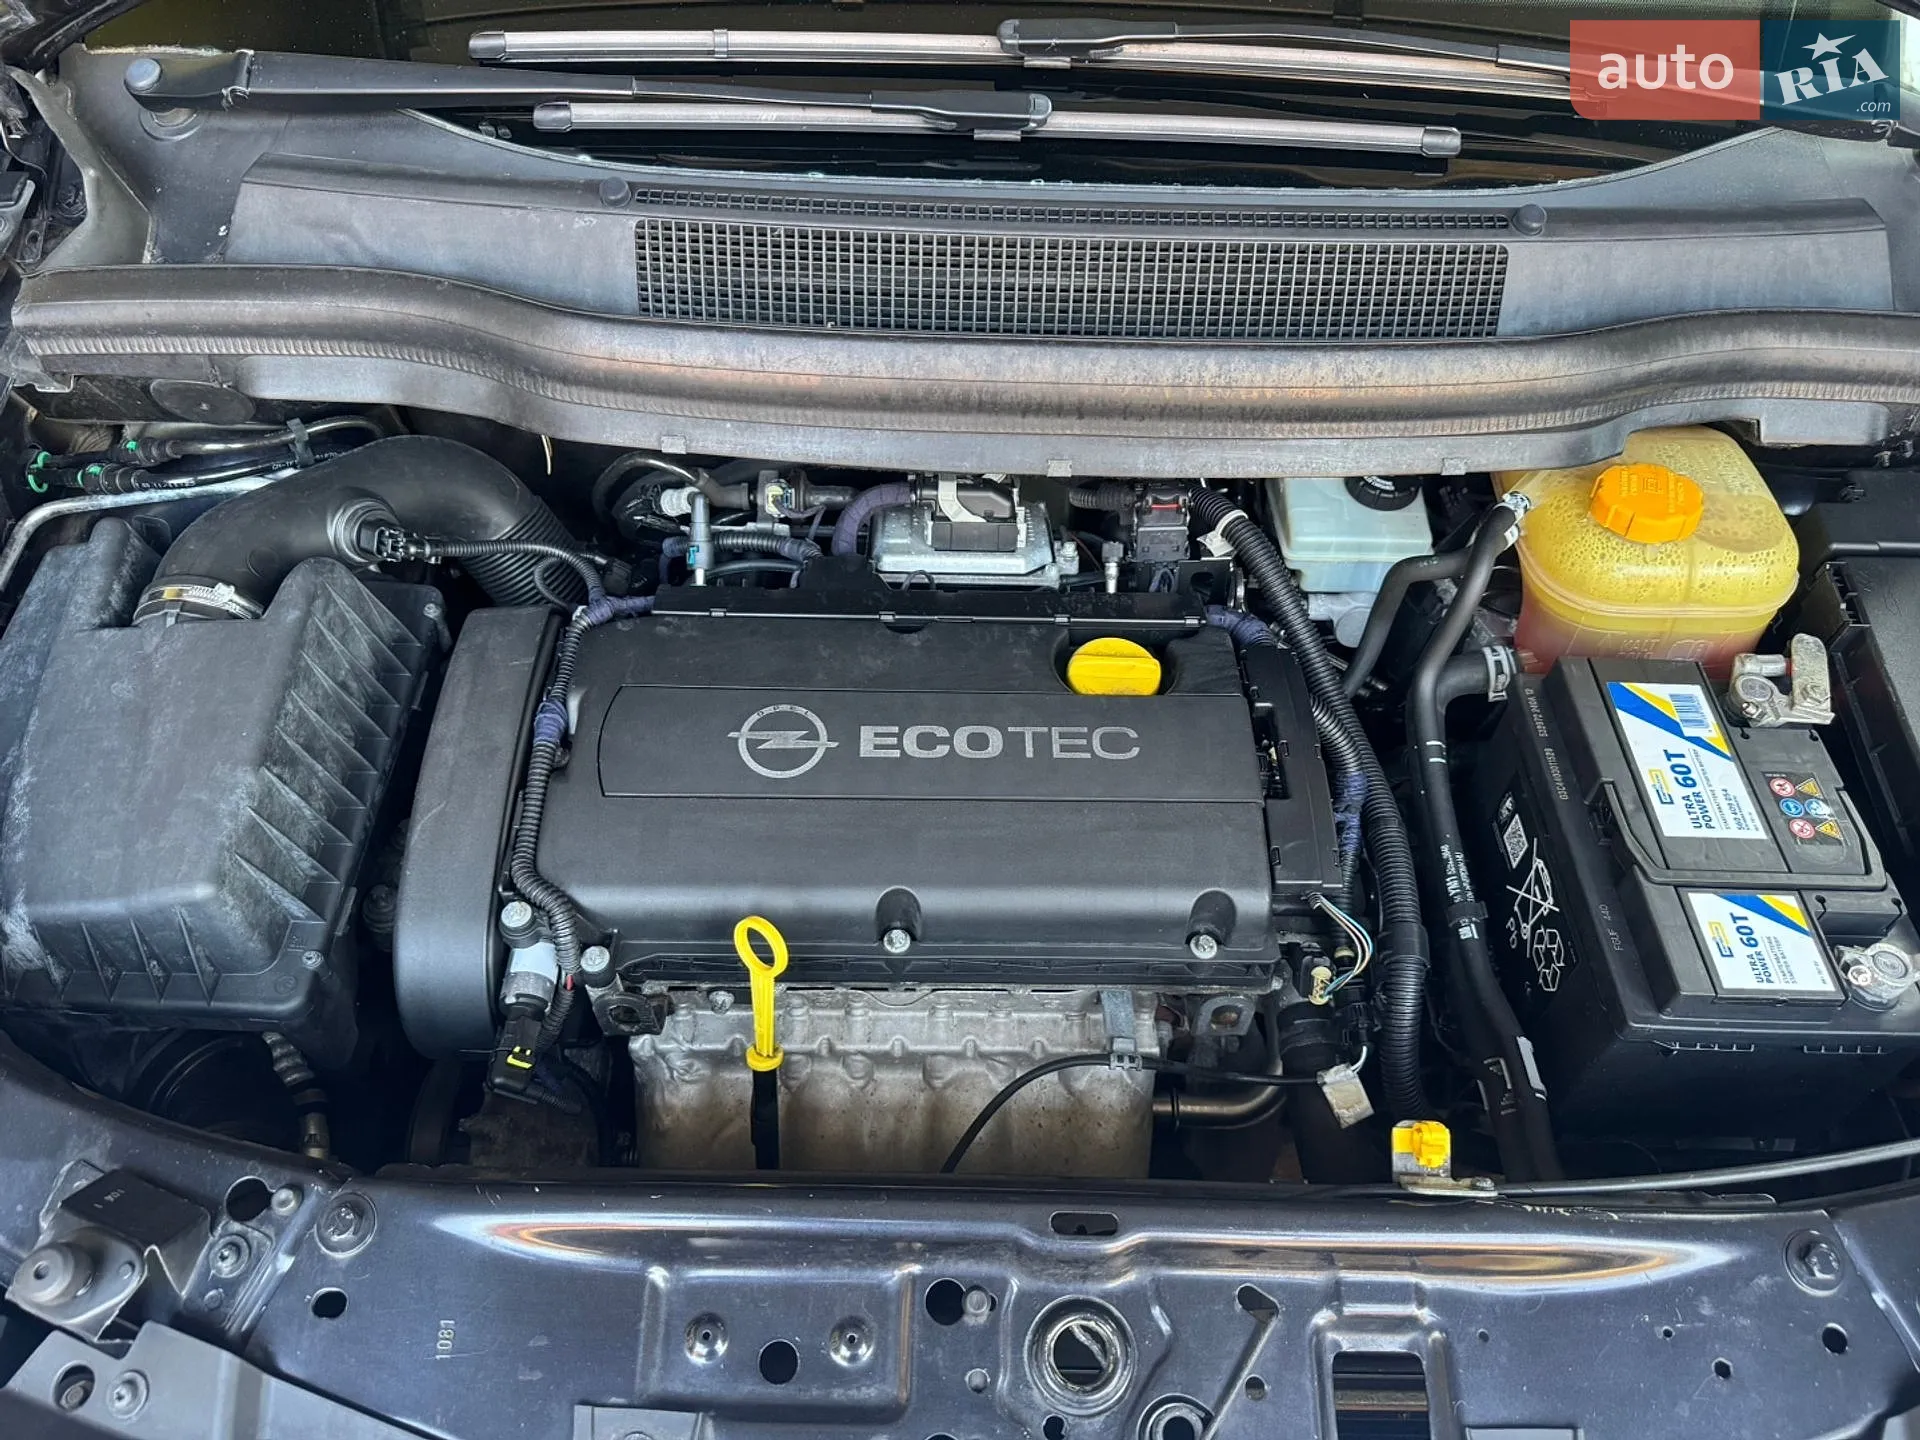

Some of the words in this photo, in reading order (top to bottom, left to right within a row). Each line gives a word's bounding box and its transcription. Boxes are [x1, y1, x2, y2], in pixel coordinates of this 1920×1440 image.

[858, 724, 1141, 761] ECOTEC
[1663, 748, 1698, 788] 60T
[1681, 794, 1703, 830] ULTRA
[1691, 791, 1716, 830] POWER
[1729, 912, 1759, 948] 60T
[1746, 953, 1764, 984] ULTRA
[1754, 950, 1775, 985] POWER
[434, 1318, 457, 1361] 1081
